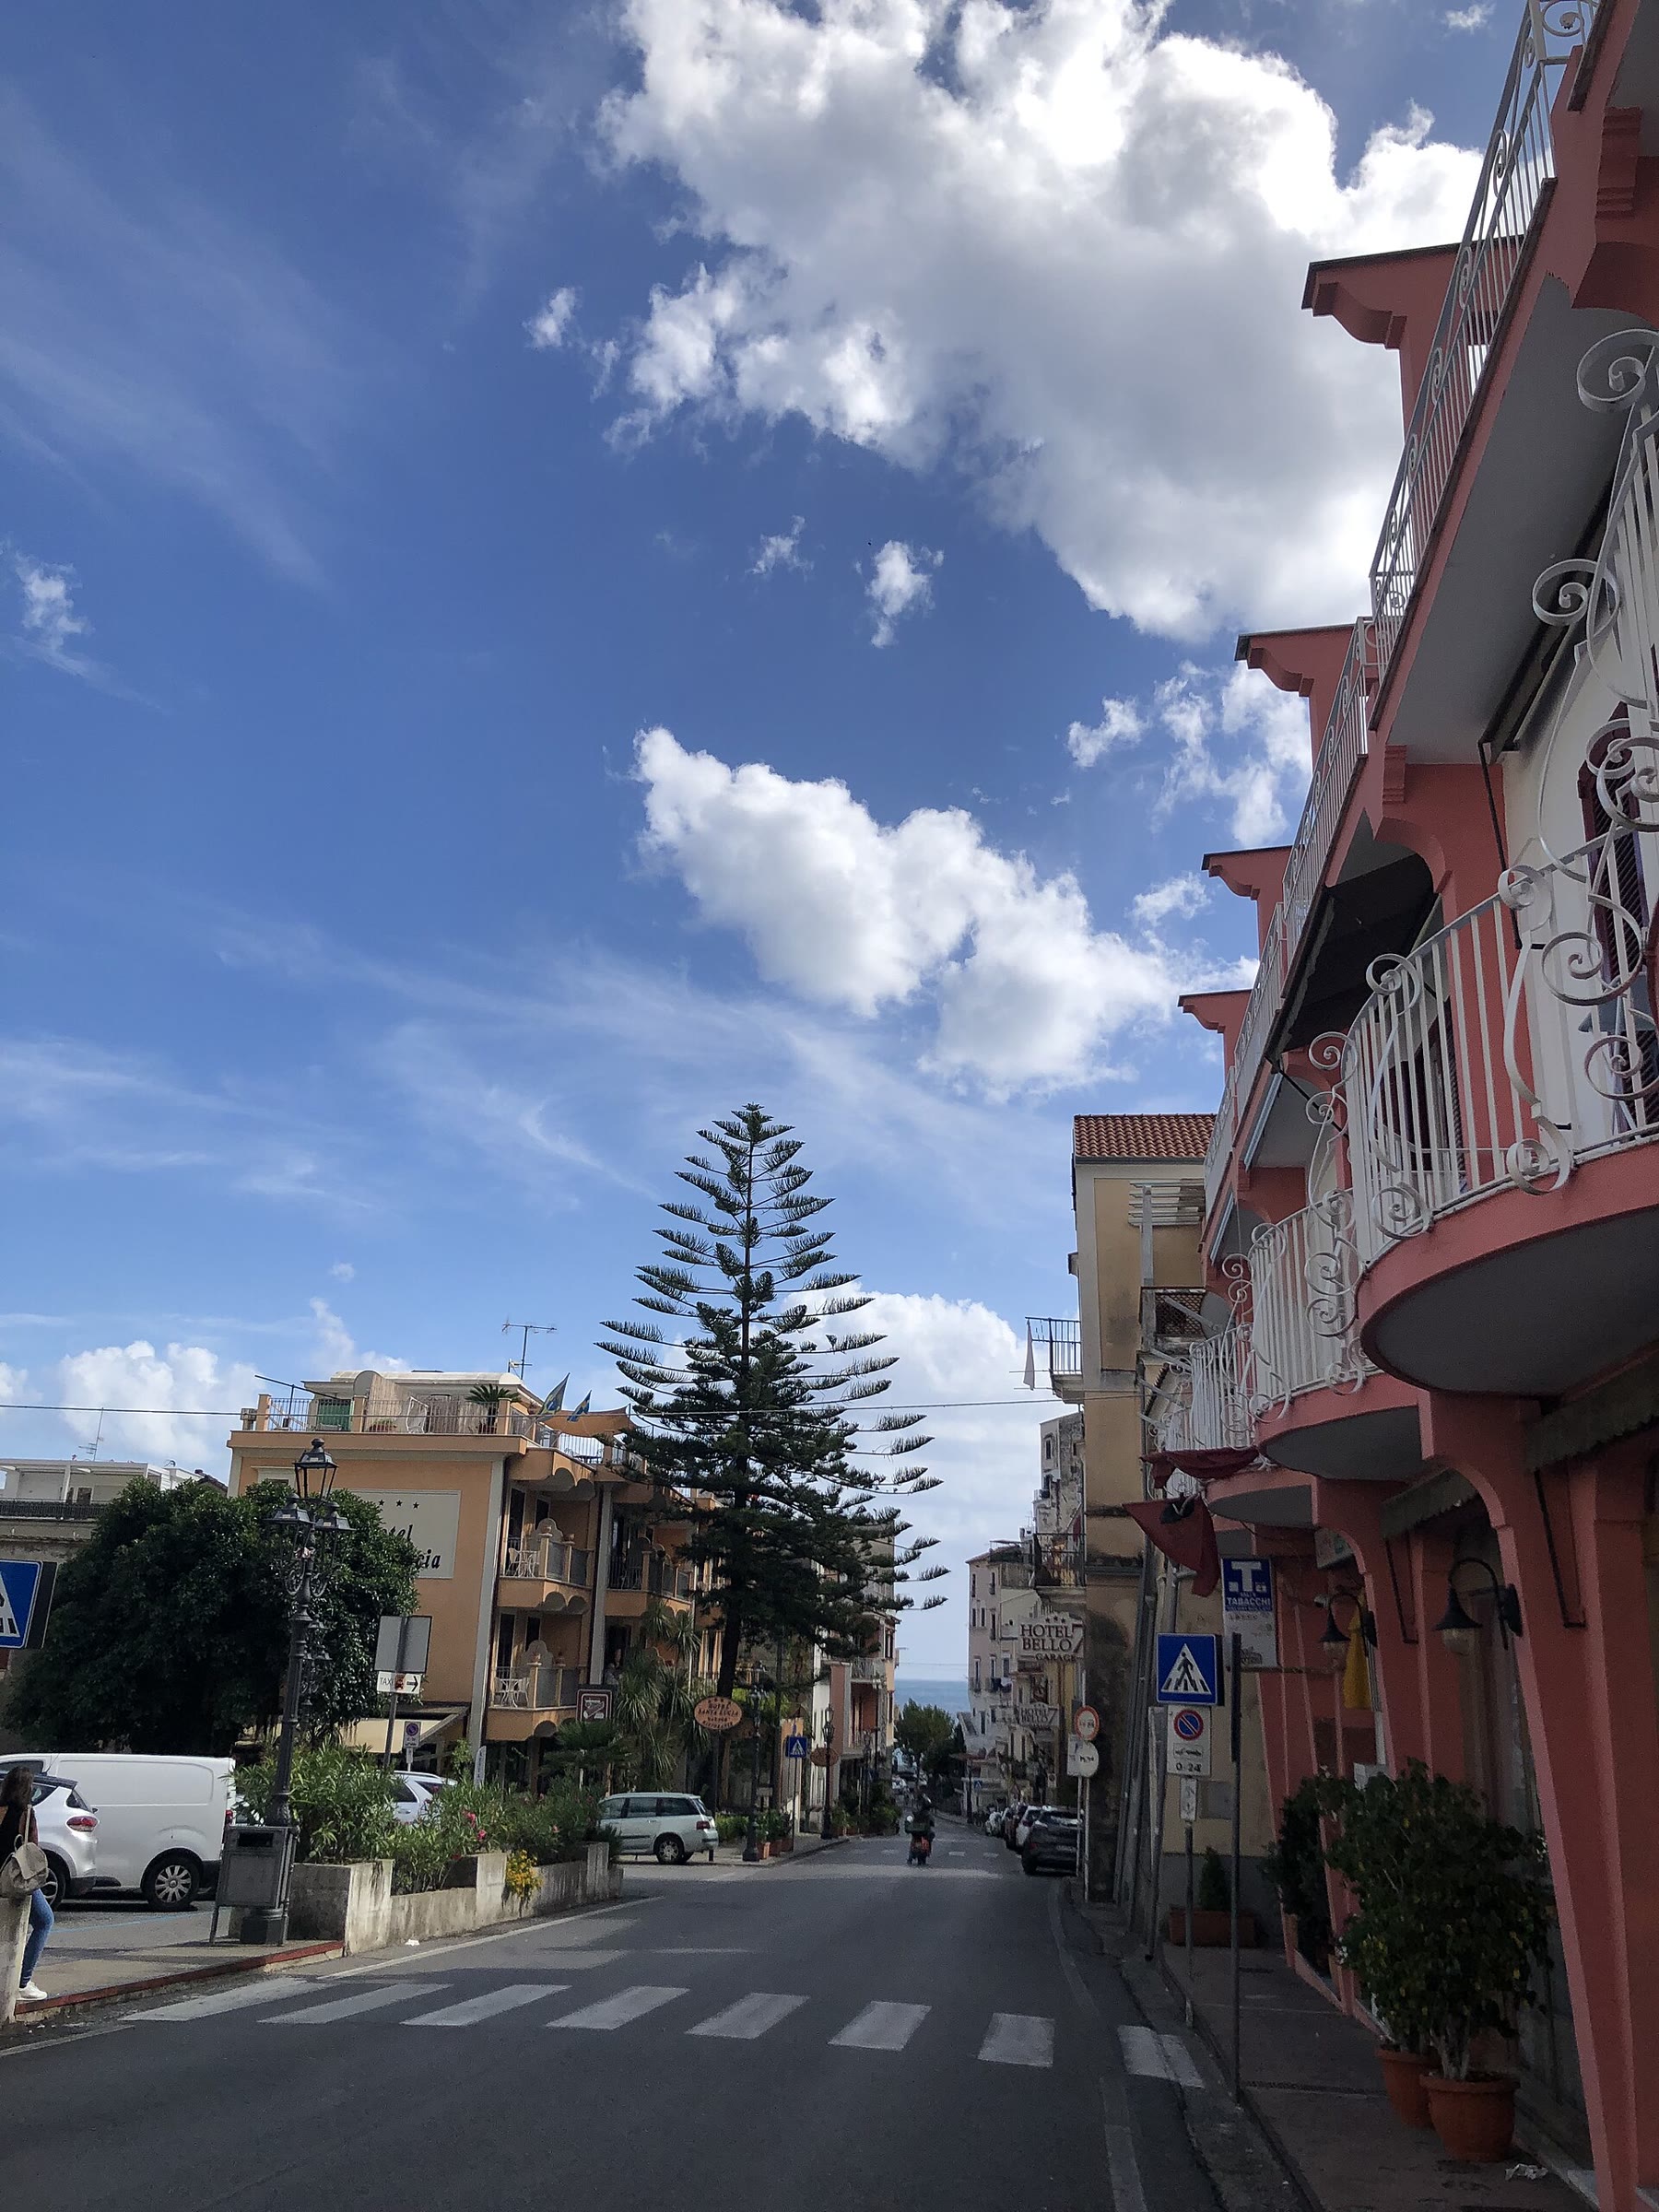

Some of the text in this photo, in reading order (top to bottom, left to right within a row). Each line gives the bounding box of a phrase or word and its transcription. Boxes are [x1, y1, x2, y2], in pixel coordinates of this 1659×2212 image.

[1227, 1597, 1271, 1606] TABACCHI
[1020, 1624, 1073, 1638] HOTEL
[1022, 1638, 1072, 1652] BELLO
[1035, 1653, 1077, 1663] GARAGE
[380, 1677, 394, 1686] TAXI
[1021, 1714, 1049, 1723] BELLO
